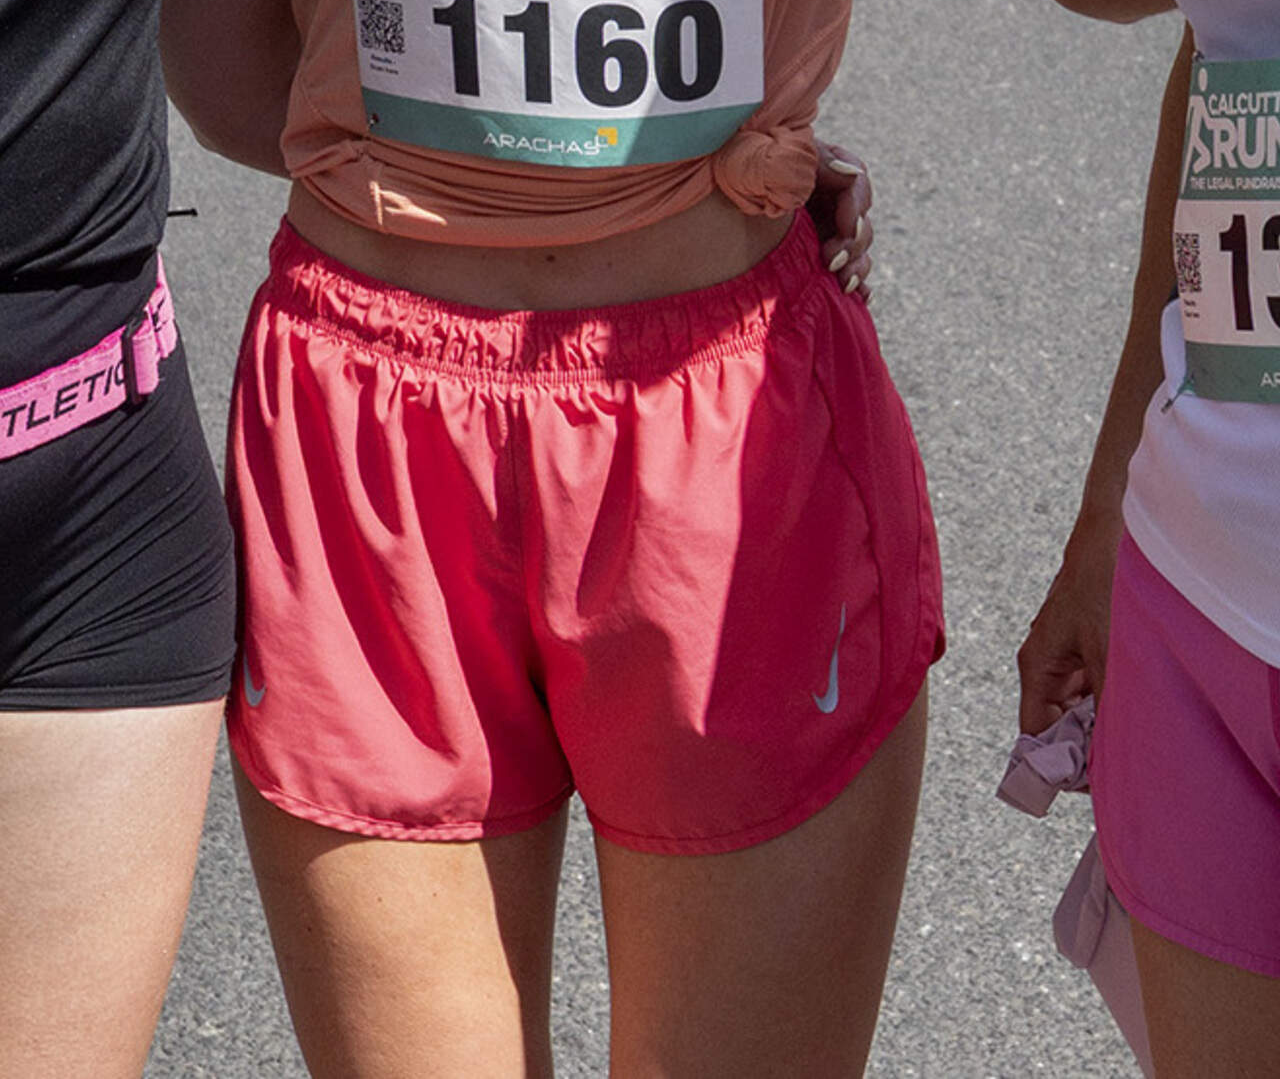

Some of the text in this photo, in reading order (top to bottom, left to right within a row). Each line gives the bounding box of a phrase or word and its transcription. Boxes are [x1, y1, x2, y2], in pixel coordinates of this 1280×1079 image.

[483, 132, 598, 156] ARACHAS
[1191, 176, 1205, 189] THE
[1206, 176, 1235, 189] LEGAL
